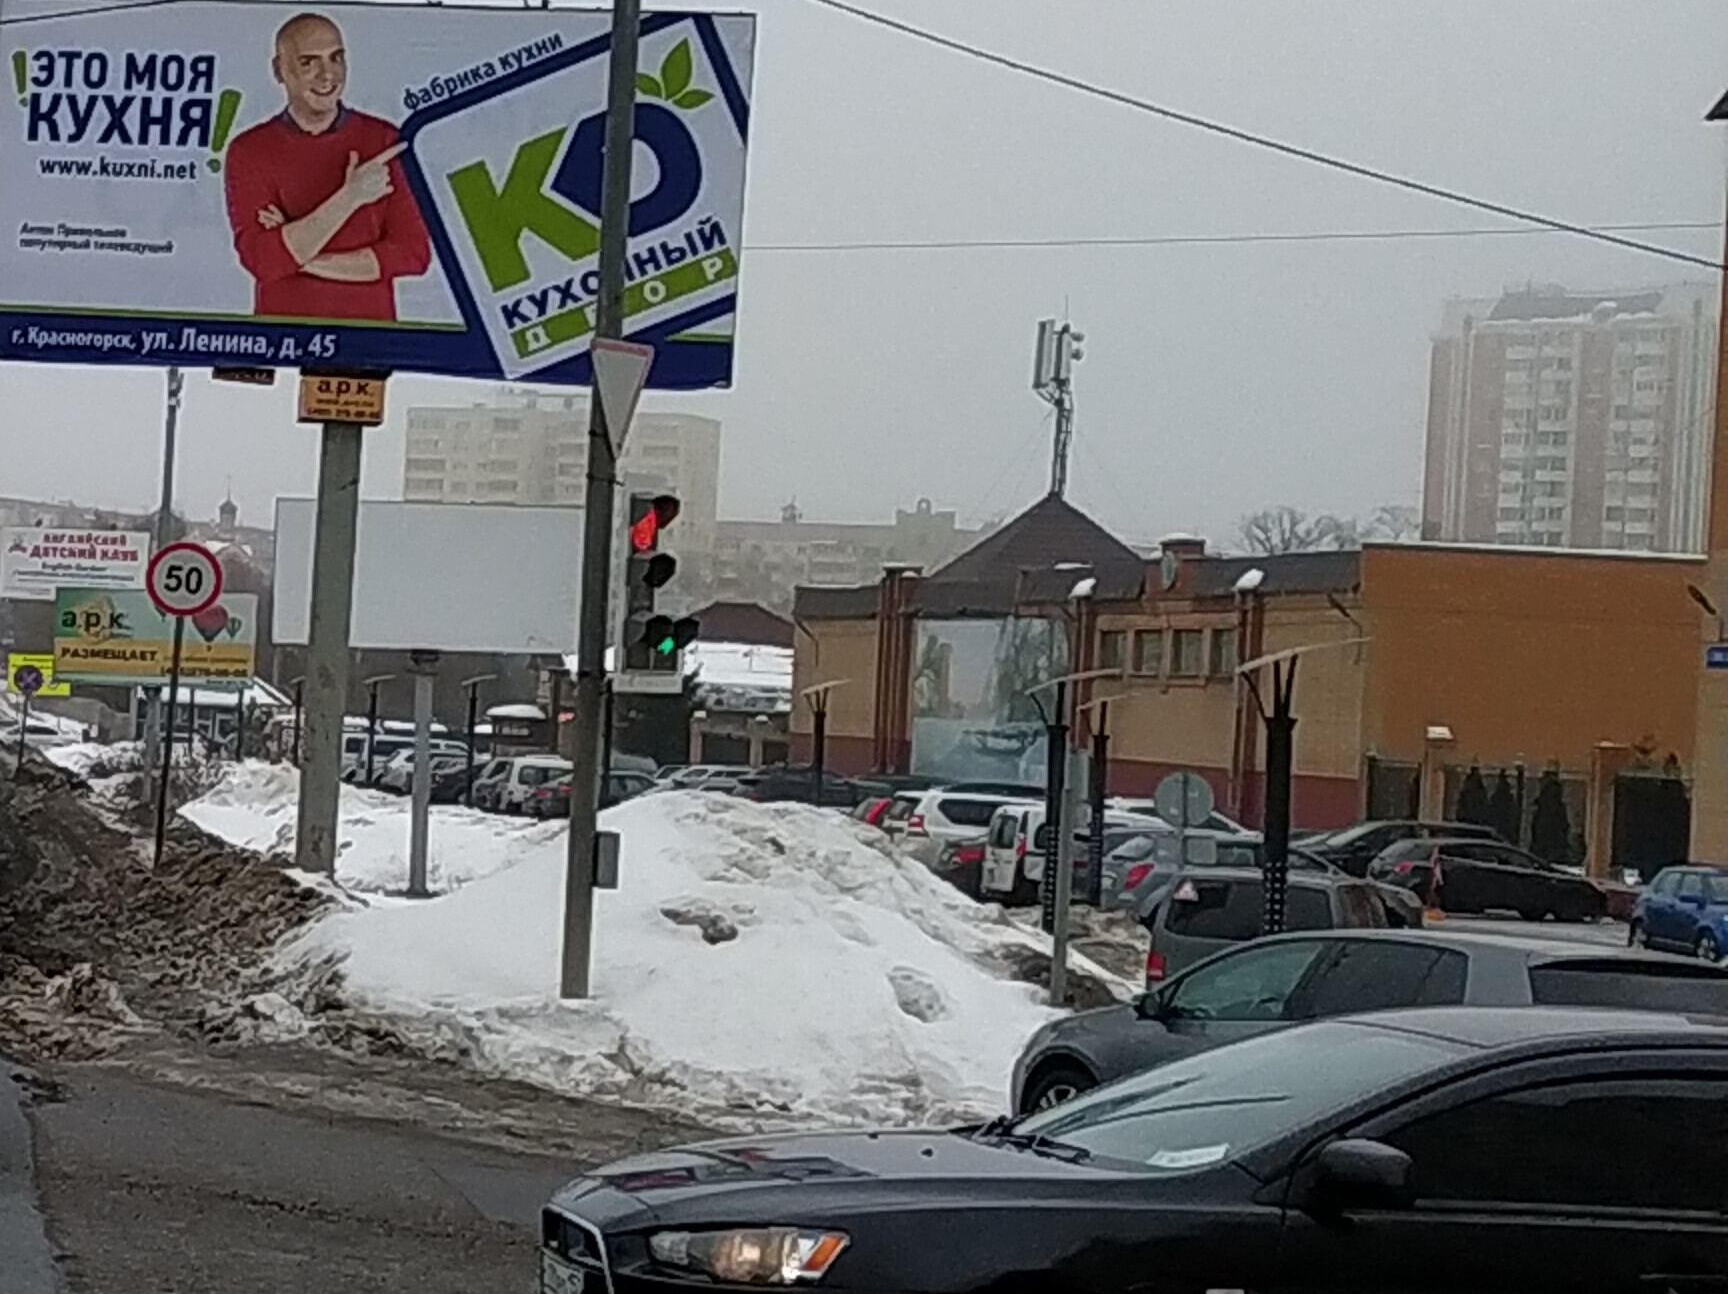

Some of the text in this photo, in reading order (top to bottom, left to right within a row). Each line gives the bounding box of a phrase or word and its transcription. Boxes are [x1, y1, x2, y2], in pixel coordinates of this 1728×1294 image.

[124, 52, 216, 93] МОЯ
[402, 32, 564, 112] фабрика кухни
[40, 156, 197, 180] www.kuxni.net
[27, 326, 136, 352] Красногорск,
[141, 329, 175, 355] ул.
[179, 327, 275, 357] Ленина,
[278, 335, 304, 360] д.
[307, 333, 337, 358] 45
[163, 564, 204, 595] 50
[60, 647, 159, 662] РАЗМЕЩАЕТ
